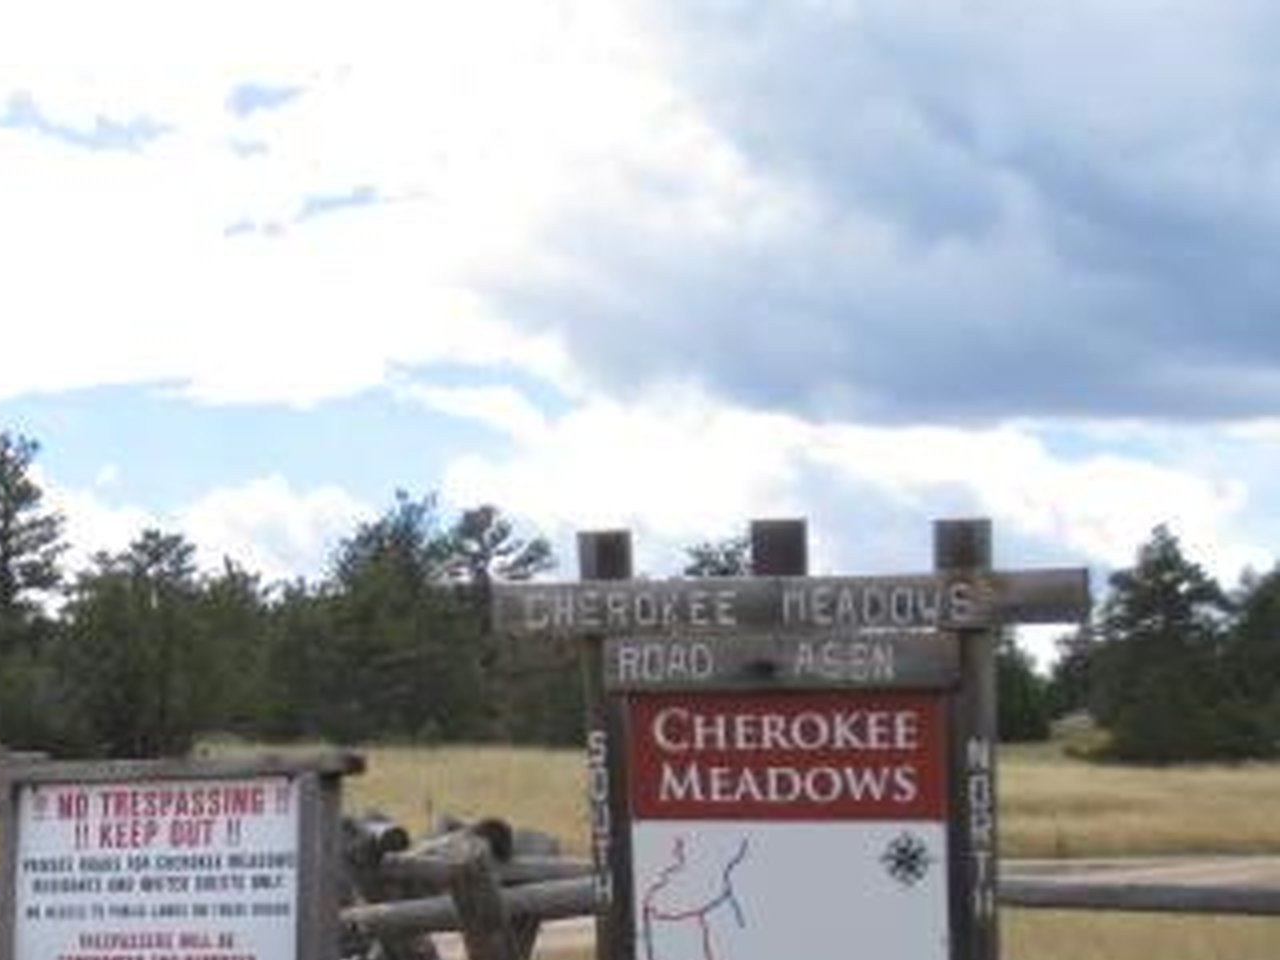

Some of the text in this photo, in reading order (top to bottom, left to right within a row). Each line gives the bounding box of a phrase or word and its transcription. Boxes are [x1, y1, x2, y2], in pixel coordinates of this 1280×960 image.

[525, 580, 972, 630] CHEROKEE MEADOWS
[618, 643, 713, 682] ROAD
[653, 706, 917, 750] CHEROKEE
[659, 761, 917, 802] MEADOWS
[58, 793, 89, 819] NO
[100, 787, 264, 819] TRESPASSING
[589, 730, 613, 903] SOUTH
[75, 817, 241, 849] !! KEEP OUT !!
[967, 736, 994, 920] NORTH
